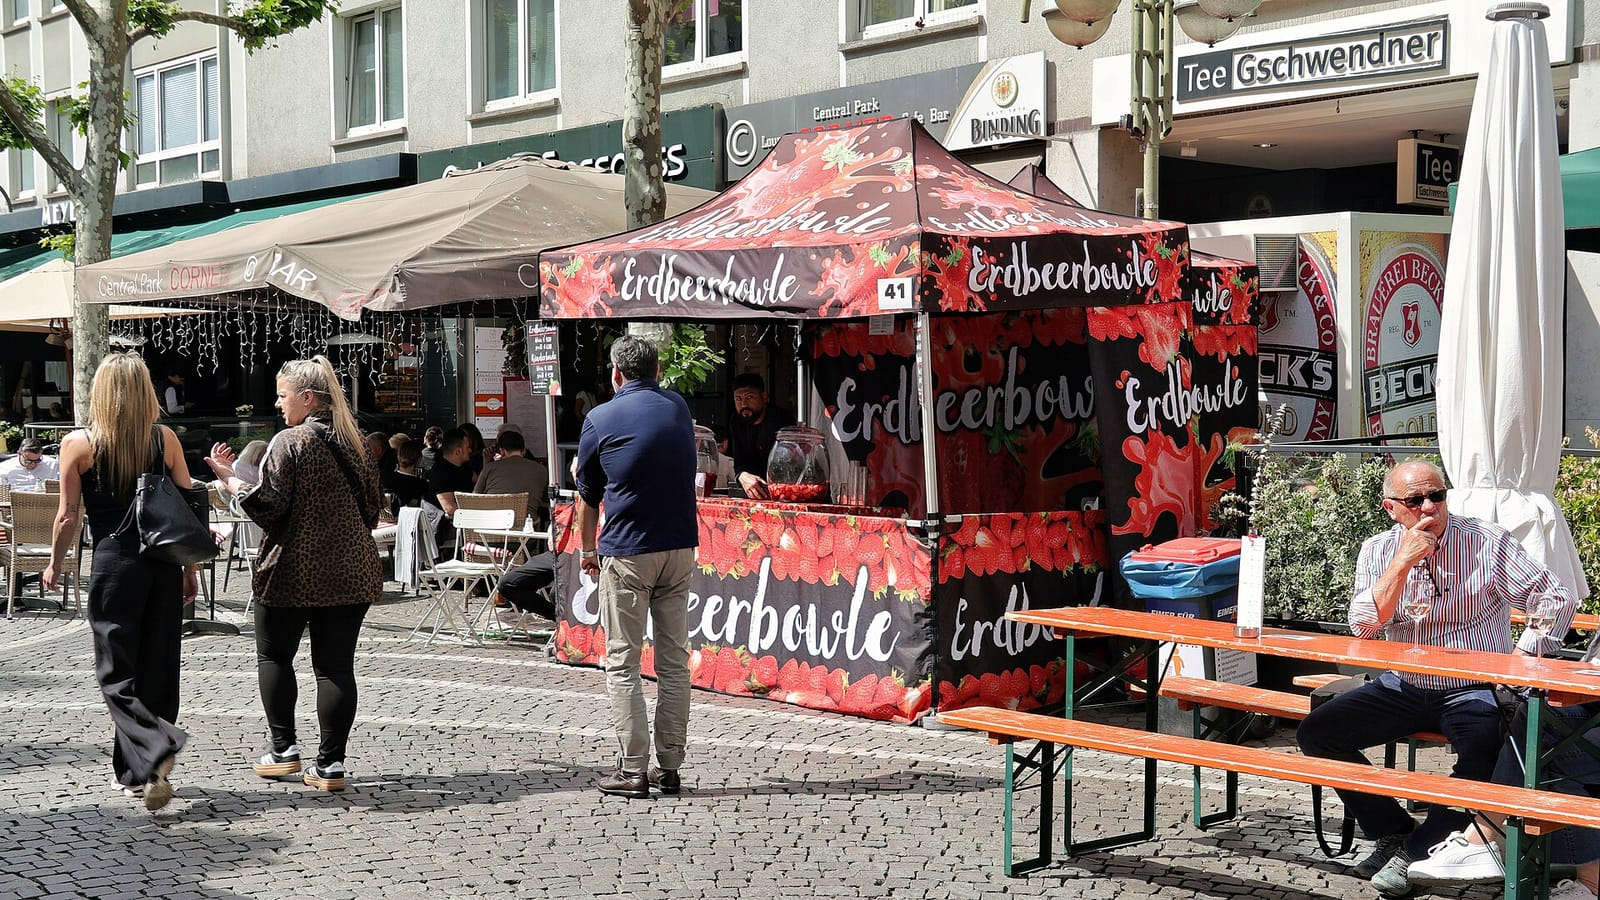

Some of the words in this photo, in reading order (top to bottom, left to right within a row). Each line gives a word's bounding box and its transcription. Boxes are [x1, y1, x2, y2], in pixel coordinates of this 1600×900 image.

[1184, 63, 1227, 92] Tee
[1236, 31, 1441, 84] Gschwendner
[813, 102, 851, 121] Central
[854, 97, 880, 114] Park
[930, 107, 949, 122] Bar
[971, 109, 1041, 144] BINDING
[1422, 149, 1452, 182] Tee
[99, 272, 138, 297] Central
[140, 269, 163, 294] Park
[620, 252, 800, 306] Erdbeerbowle
[968, 240, 1158, 297] Erdbeerbowle
[884, 283, 906, 300] 41
[1366, 258, 1409, 364] BRAUEREI
[1369, 362, 1437, 407] BECK
